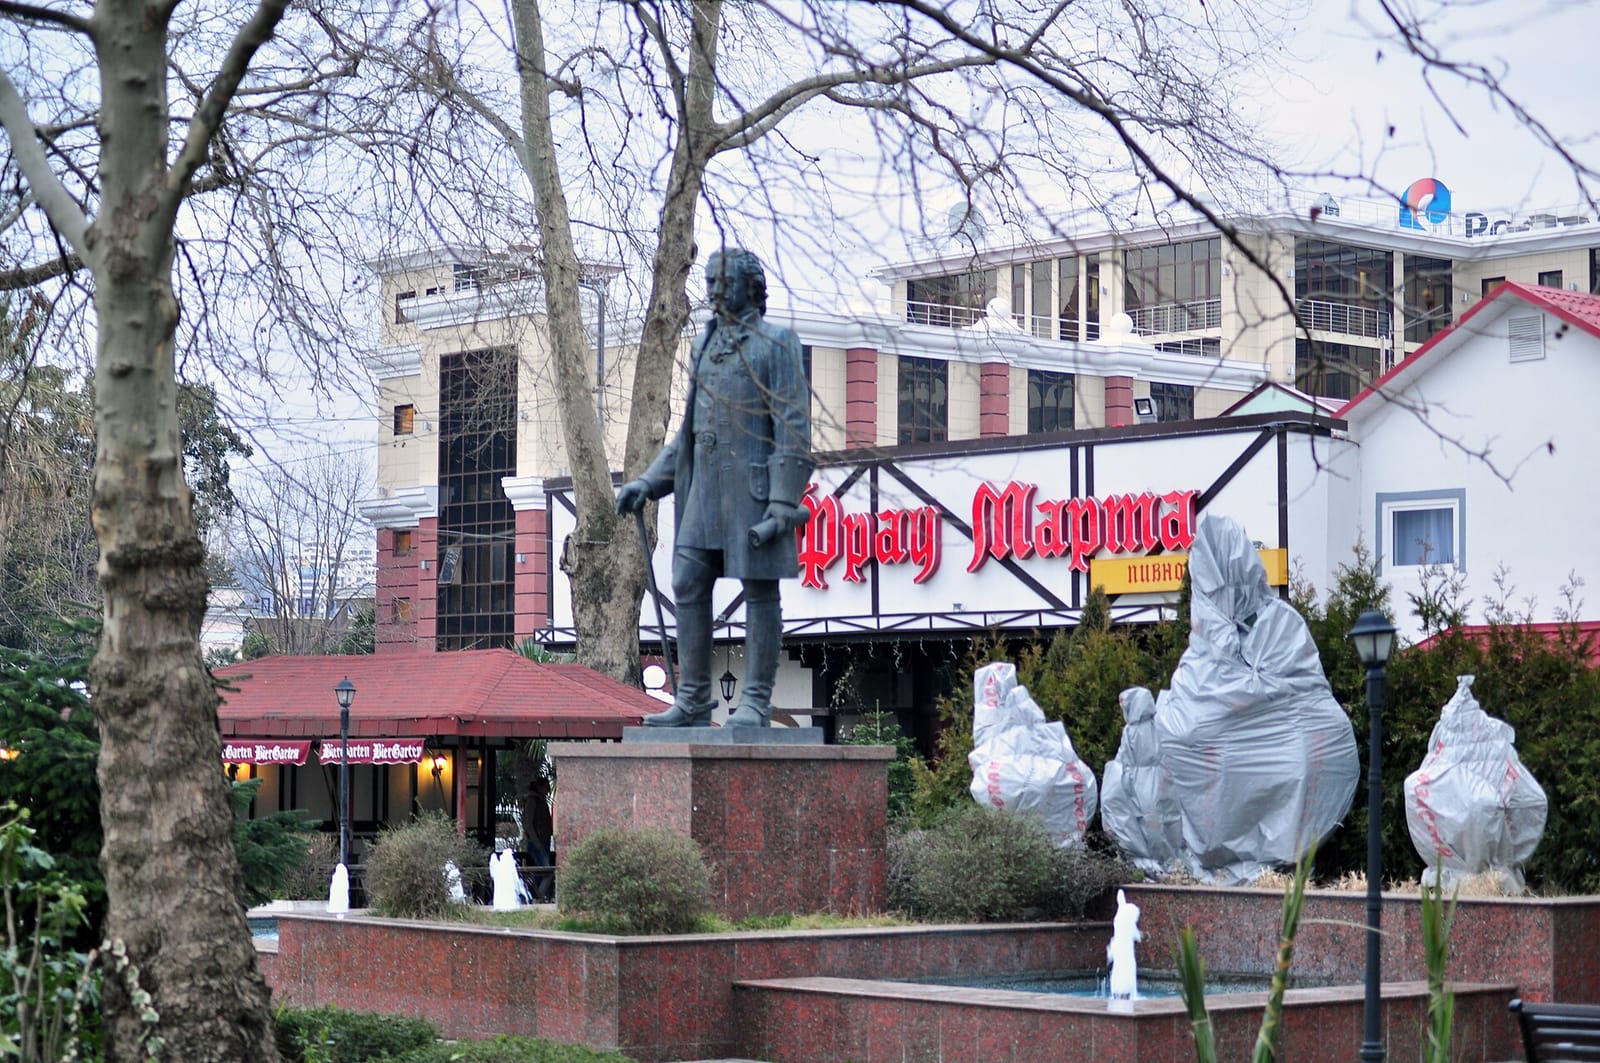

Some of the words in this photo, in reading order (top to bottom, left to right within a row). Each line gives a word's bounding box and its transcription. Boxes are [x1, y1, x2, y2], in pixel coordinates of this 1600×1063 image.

[795, 482, 943, 589] Фрау
[966, 480, 1200, 573] Марта
[254, 744, 299, 761] BierGarten
